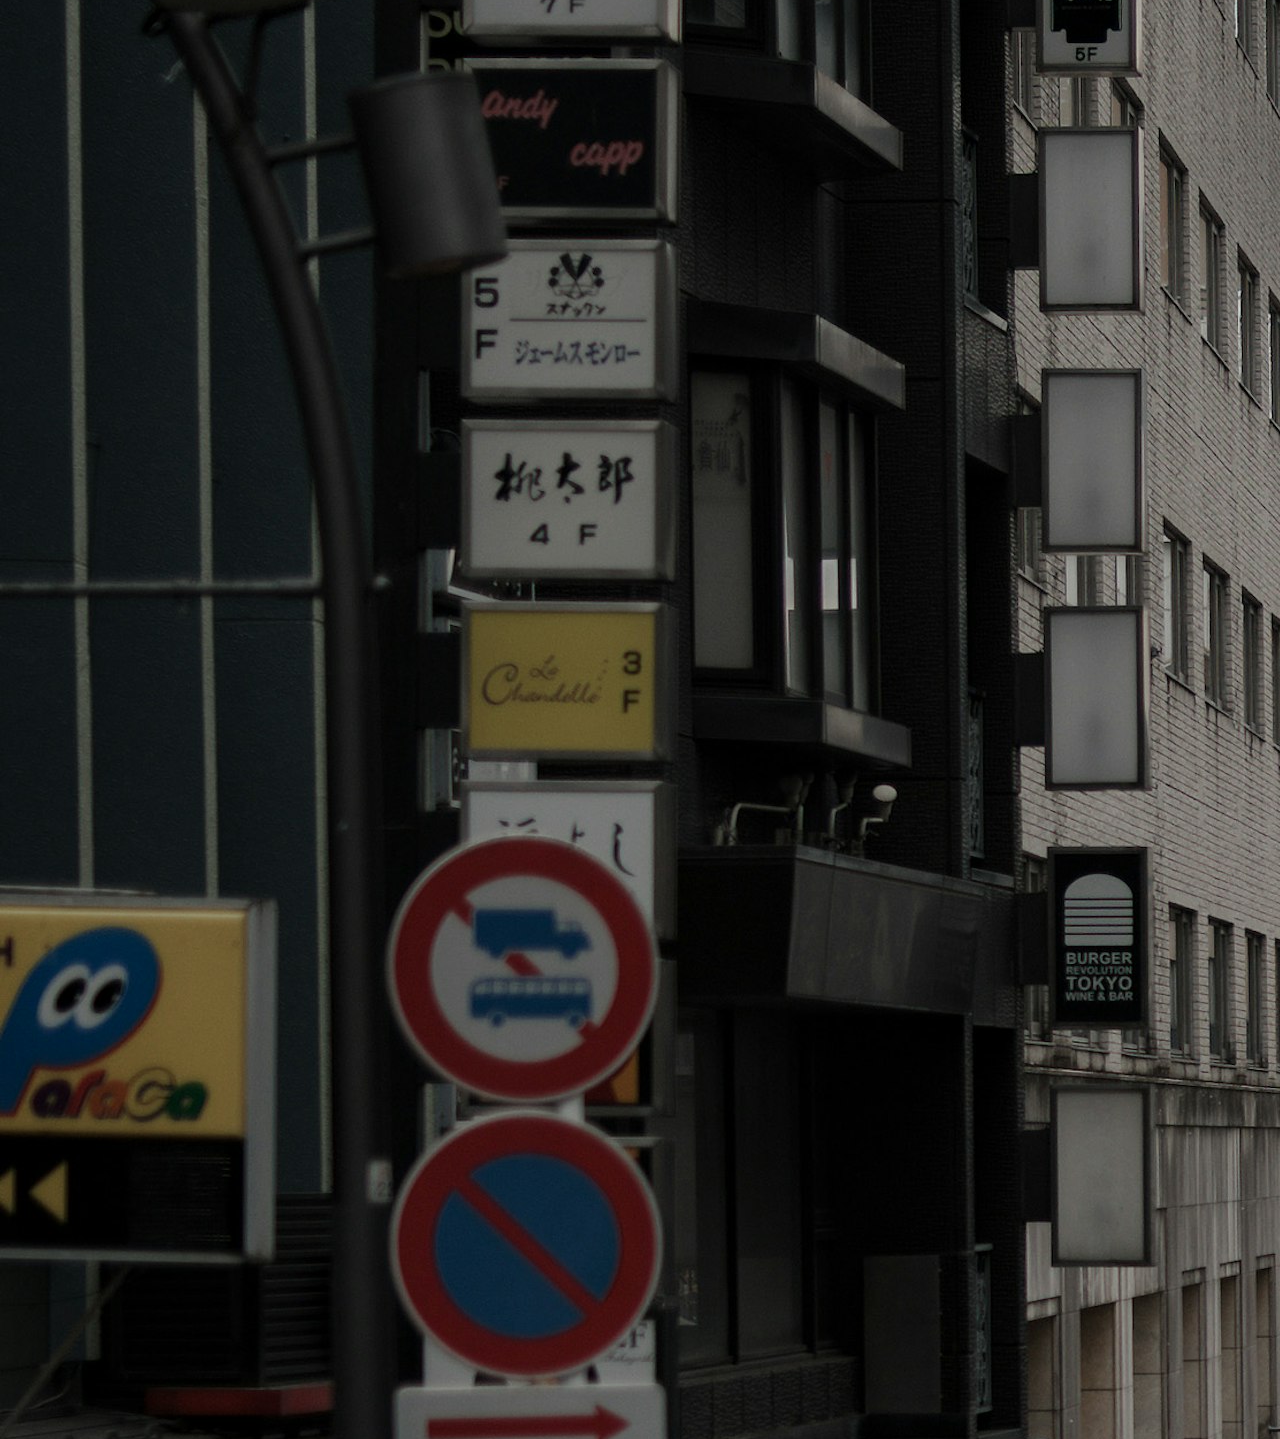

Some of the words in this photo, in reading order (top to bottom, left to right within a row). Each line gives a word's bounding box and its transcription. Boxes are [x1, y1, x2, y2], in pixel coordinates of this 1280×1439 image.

[1075, 47, 1098, 61] 5F
[516, 341, 641, 364] ジェームスモンロー
[494, 452, 634, 504] 桃太郎
[1066, 951, 1133, 965] BURGER
[1066, 966, 1133, 975] REVOLUTION
[1066, 976, 1133, 991] TOKYO
[1065, 991, 1094, 1002] WINE
[1109, 991, 1134, 1002] BAR
